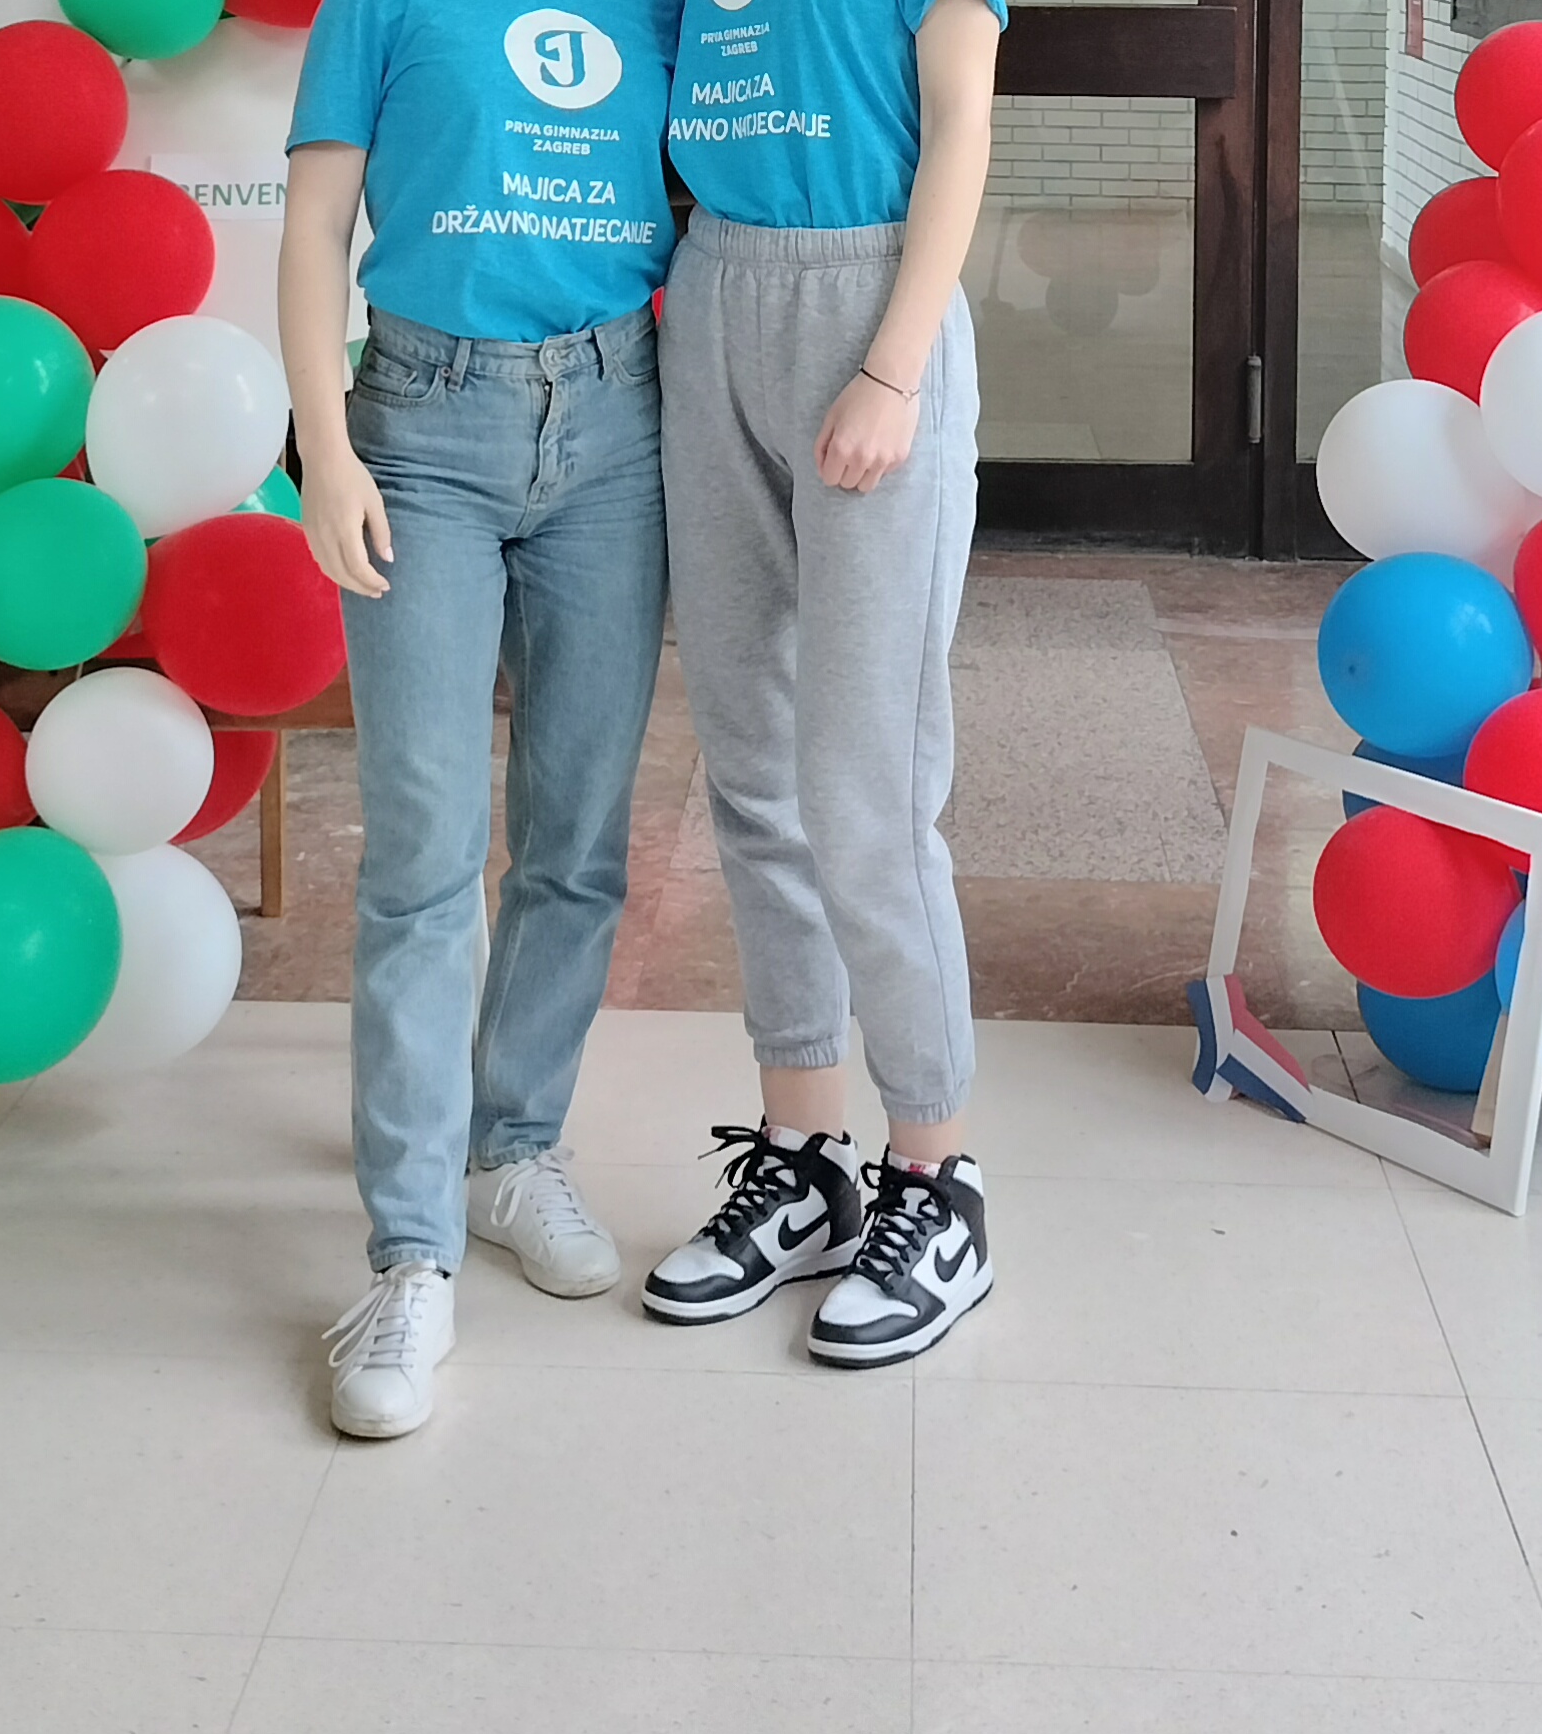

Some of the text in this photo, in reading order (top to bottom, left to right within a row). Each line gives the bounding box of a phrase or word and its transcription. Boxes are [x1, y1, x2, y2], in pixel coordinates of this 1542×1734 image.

[720, 40, 759, 57] ZAGREB
[691, 72, 775, 105] MAJICA ZA
[504, 119, 621, 142] PRVA GIMNAZIJA
[668, 117, 729, 142] AVNO
[532, 138, 592, 156] ZAGREB
[179, 182, 288, 207] ENVEN
[502, 170, 617, 205] MAJICA ZA
[431, 203, 658, 245] DRŽAVNO NATJECANJE
